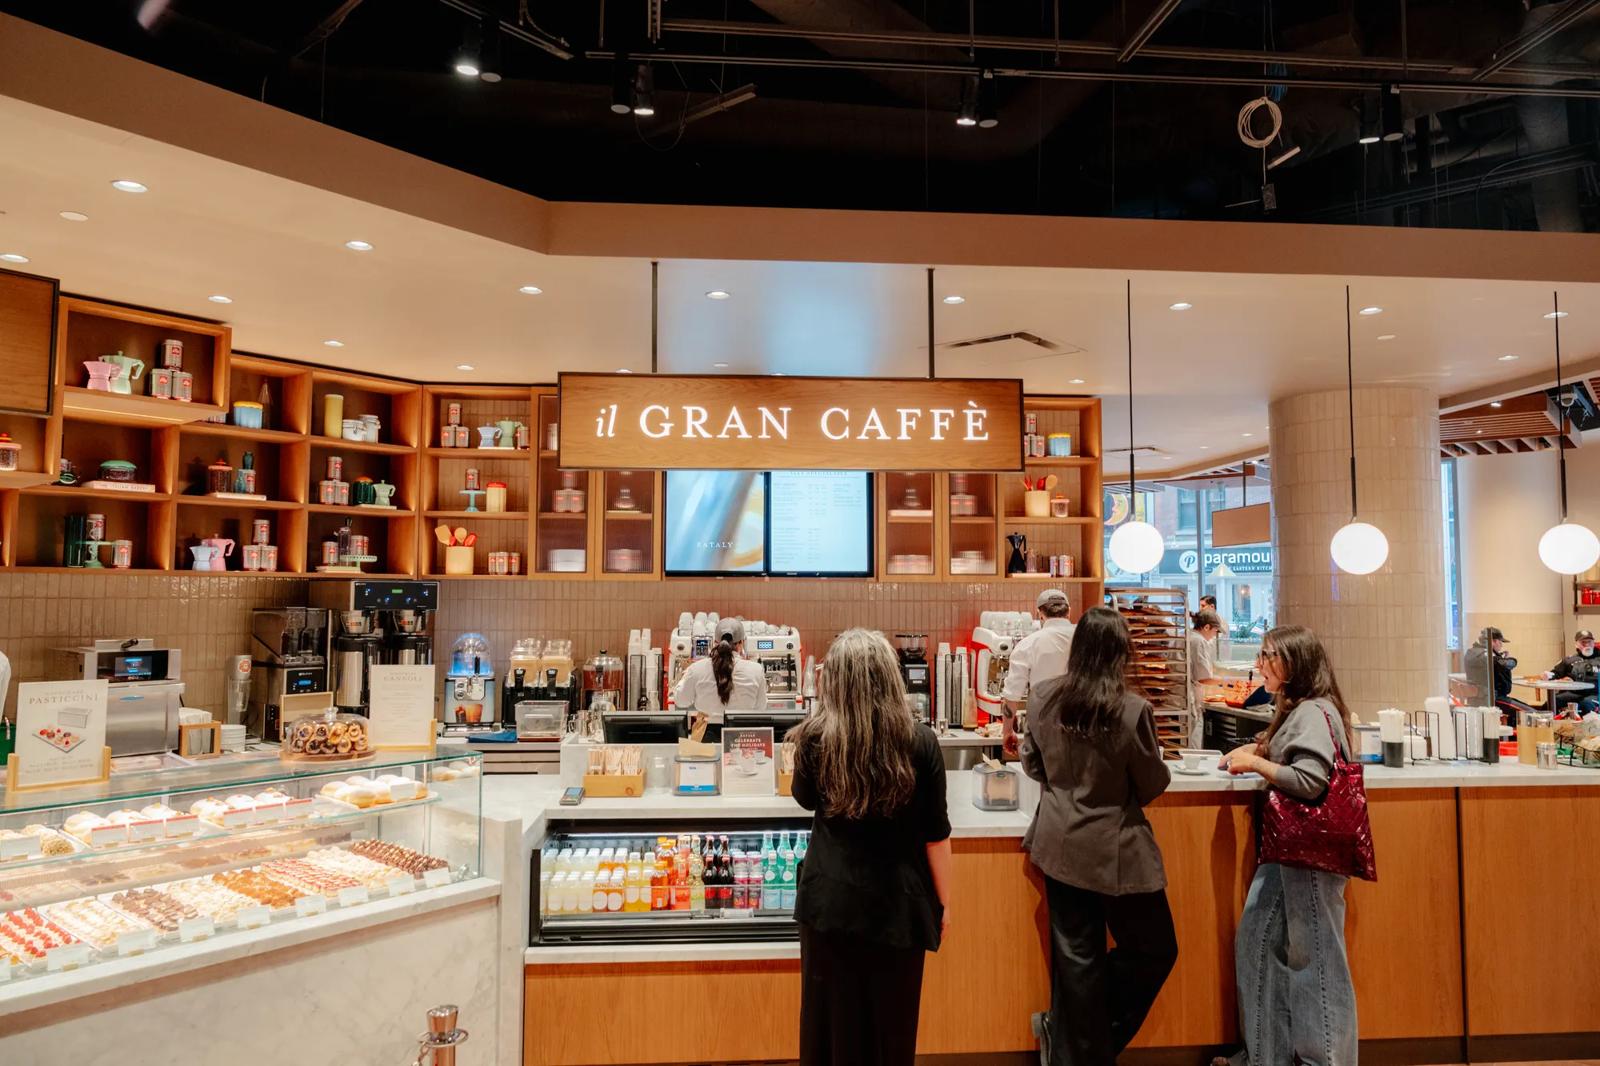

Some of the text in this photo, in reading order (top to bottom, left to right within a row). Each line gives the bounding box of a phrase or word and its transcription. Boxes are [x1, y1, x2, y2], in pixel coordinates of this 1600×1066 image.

[595, 400, 990, 441] il GRAN CAFFÈ
[29, 693, 99, 704] PASTICCINI
